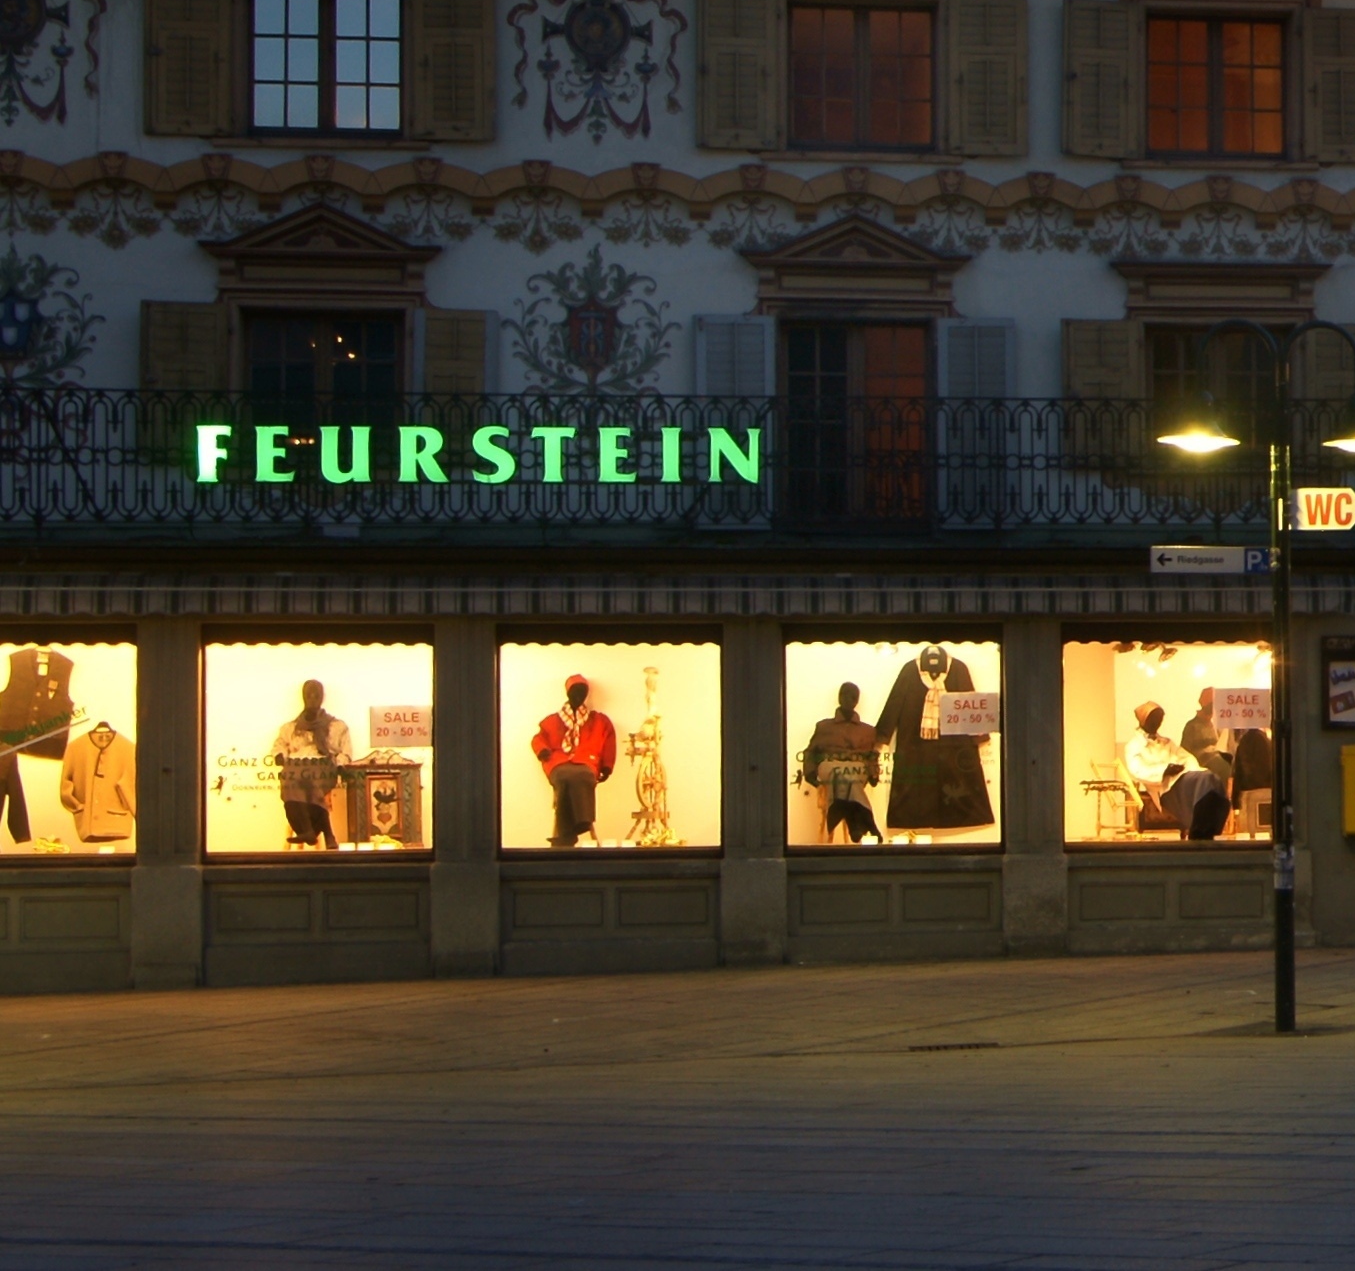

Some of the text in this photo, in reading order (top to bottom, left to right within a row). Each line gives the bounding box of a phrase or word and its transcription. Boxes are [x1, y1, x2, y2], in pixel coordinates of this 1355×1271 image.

[196, 424, 761, 484] FEURSTEIN
[1305, 493, 1353, 526] WC
[1177, 551, 1262, 571] Riedgasse P
[953, 699, 988, 710] SALE
[1226, 694, 1259, 705] SALE
[384, 712, 420, 723] SALE
[946, 714, 960, 724] 20
[969, 714, 982, 723] 50
[985, 713, 995, 723] %
[1219, 709, 1232, 718] 20
[1242, 709, 1254, 718] 50
[1257, 709, 1267, 718] %
[376, 727, 389, 737] 20
[400, 727, 414, 737] 50
[416, 727, 428, 737] %
[218, 755, 258, 768] GANZ
